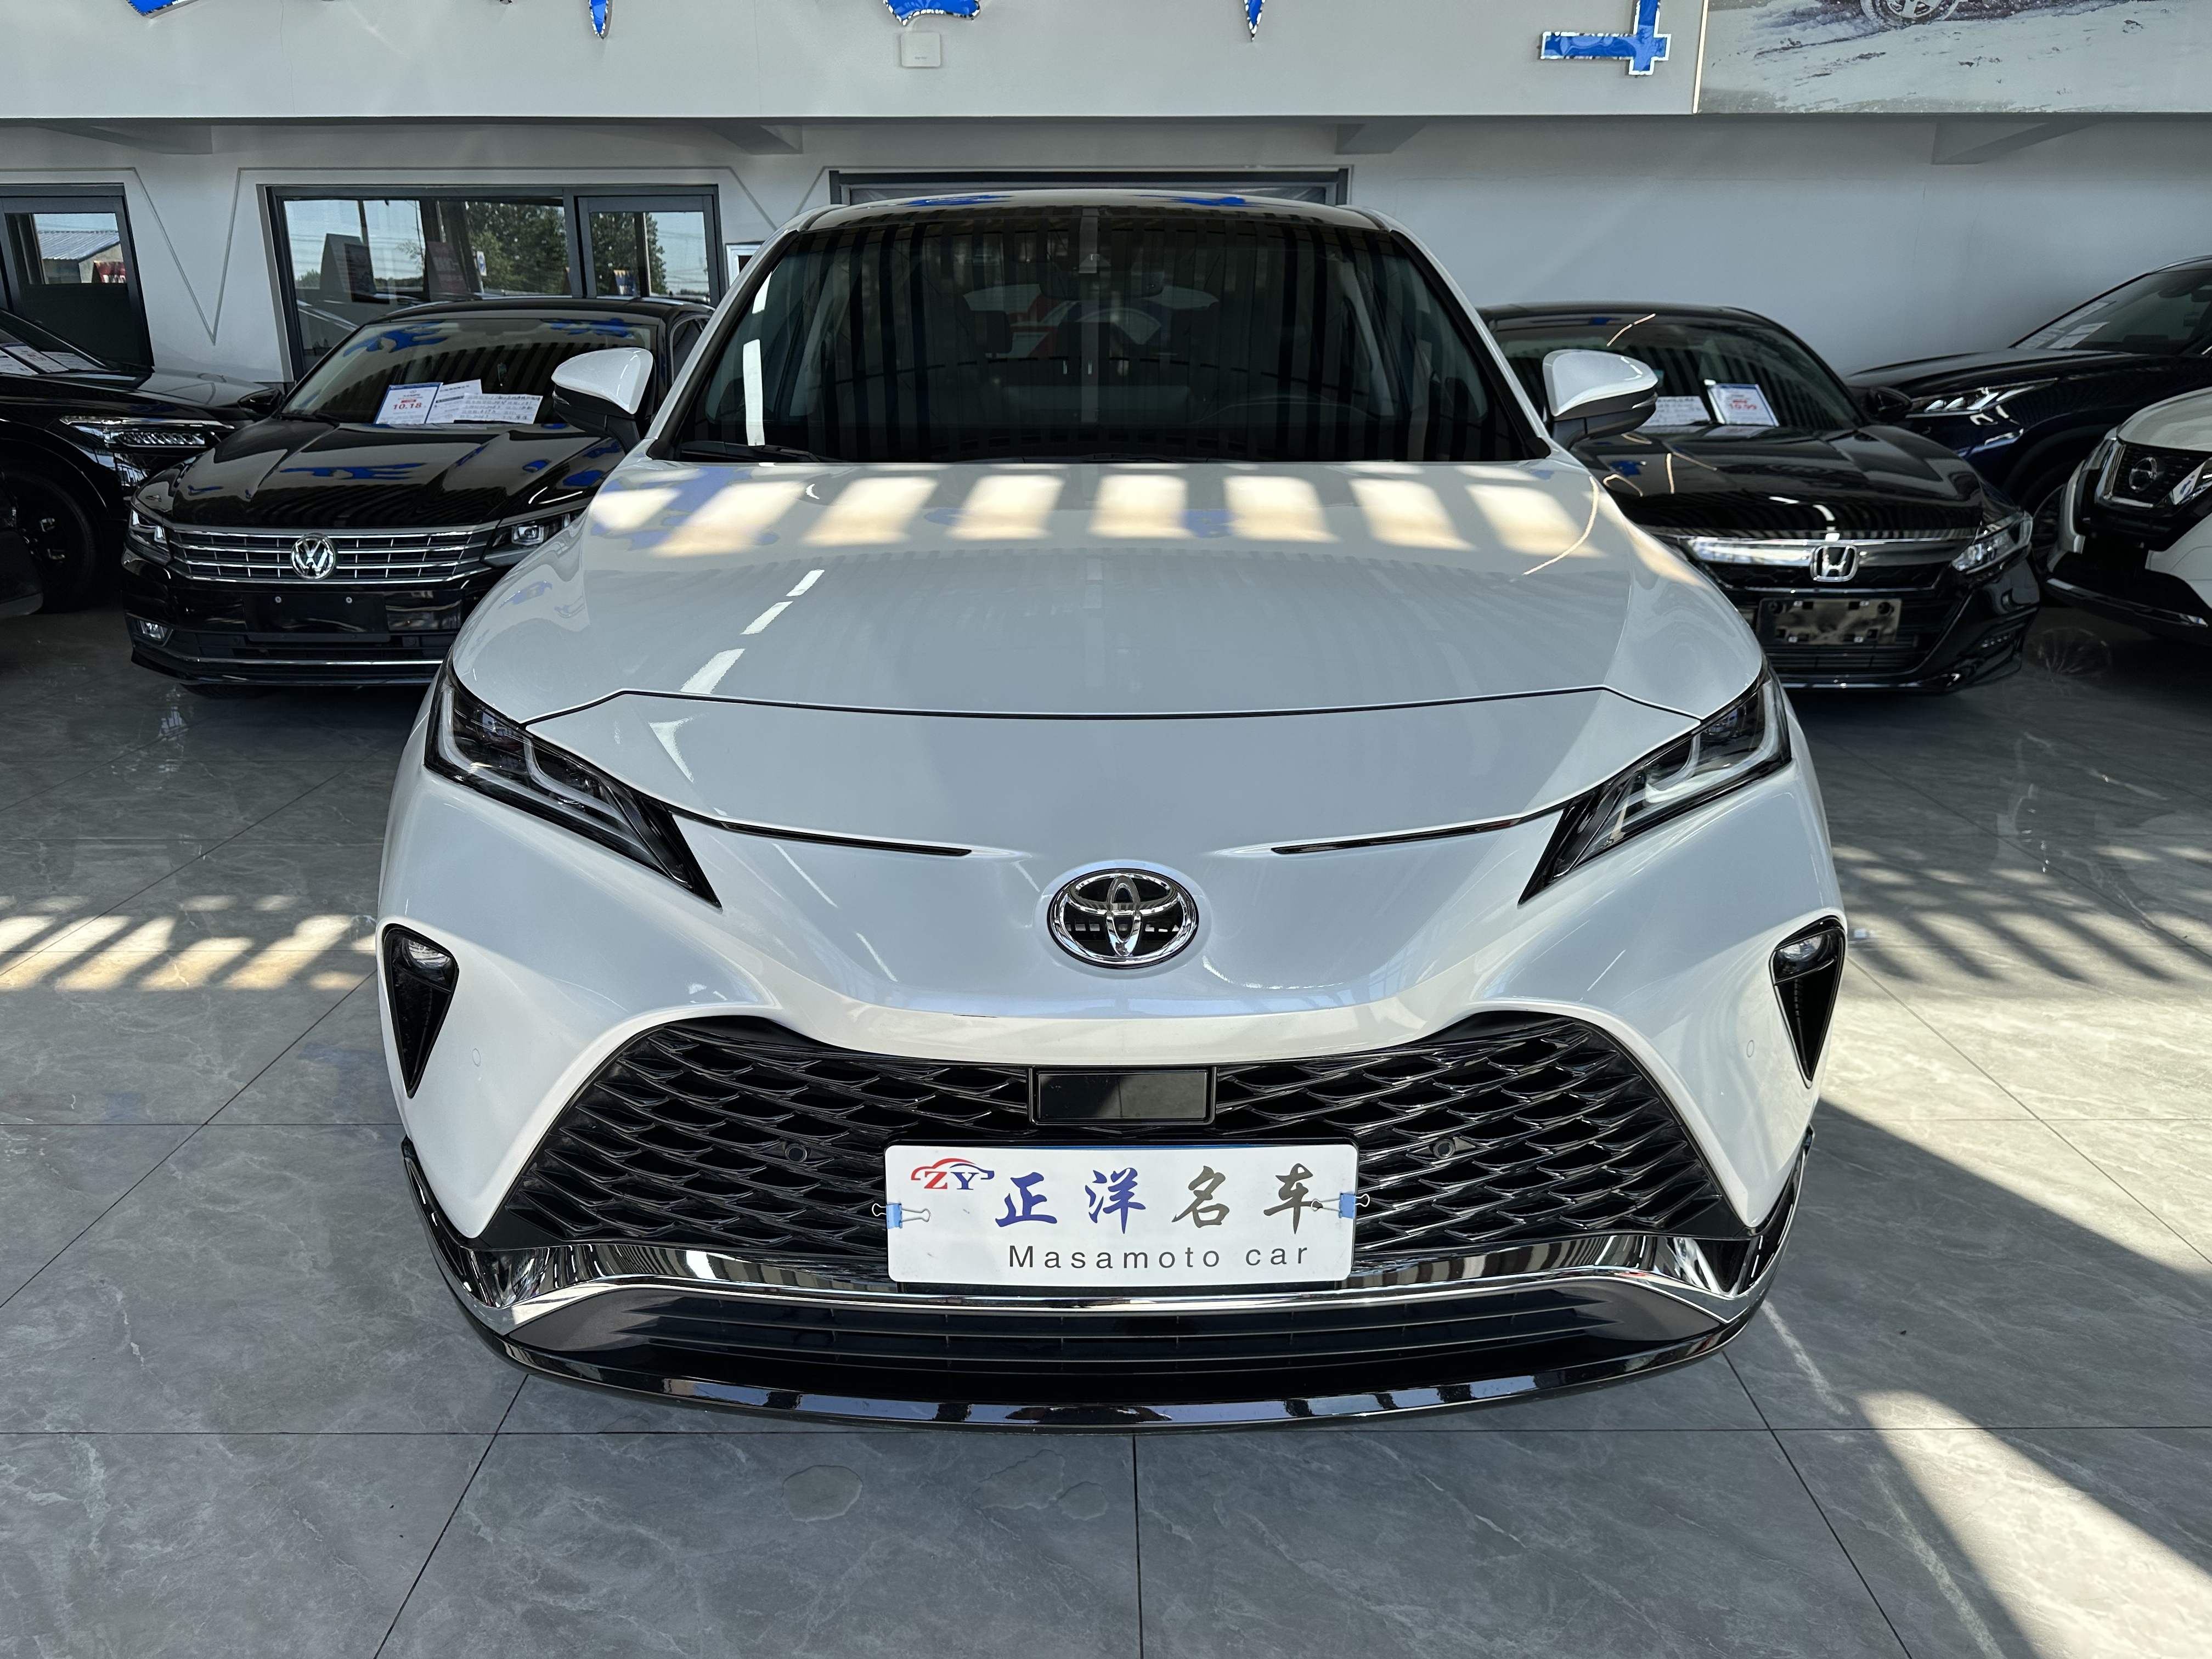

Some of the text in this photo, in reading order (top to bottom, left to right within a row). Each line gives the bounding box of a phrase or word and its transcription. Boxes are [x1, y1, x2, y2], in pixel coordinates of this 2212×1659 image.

[924, 1171, 980, 1190] ZY
[995, 1163, 1324, 1235] 正洋名车
[1009, 1245, 1307, 1269] Masamoto car
